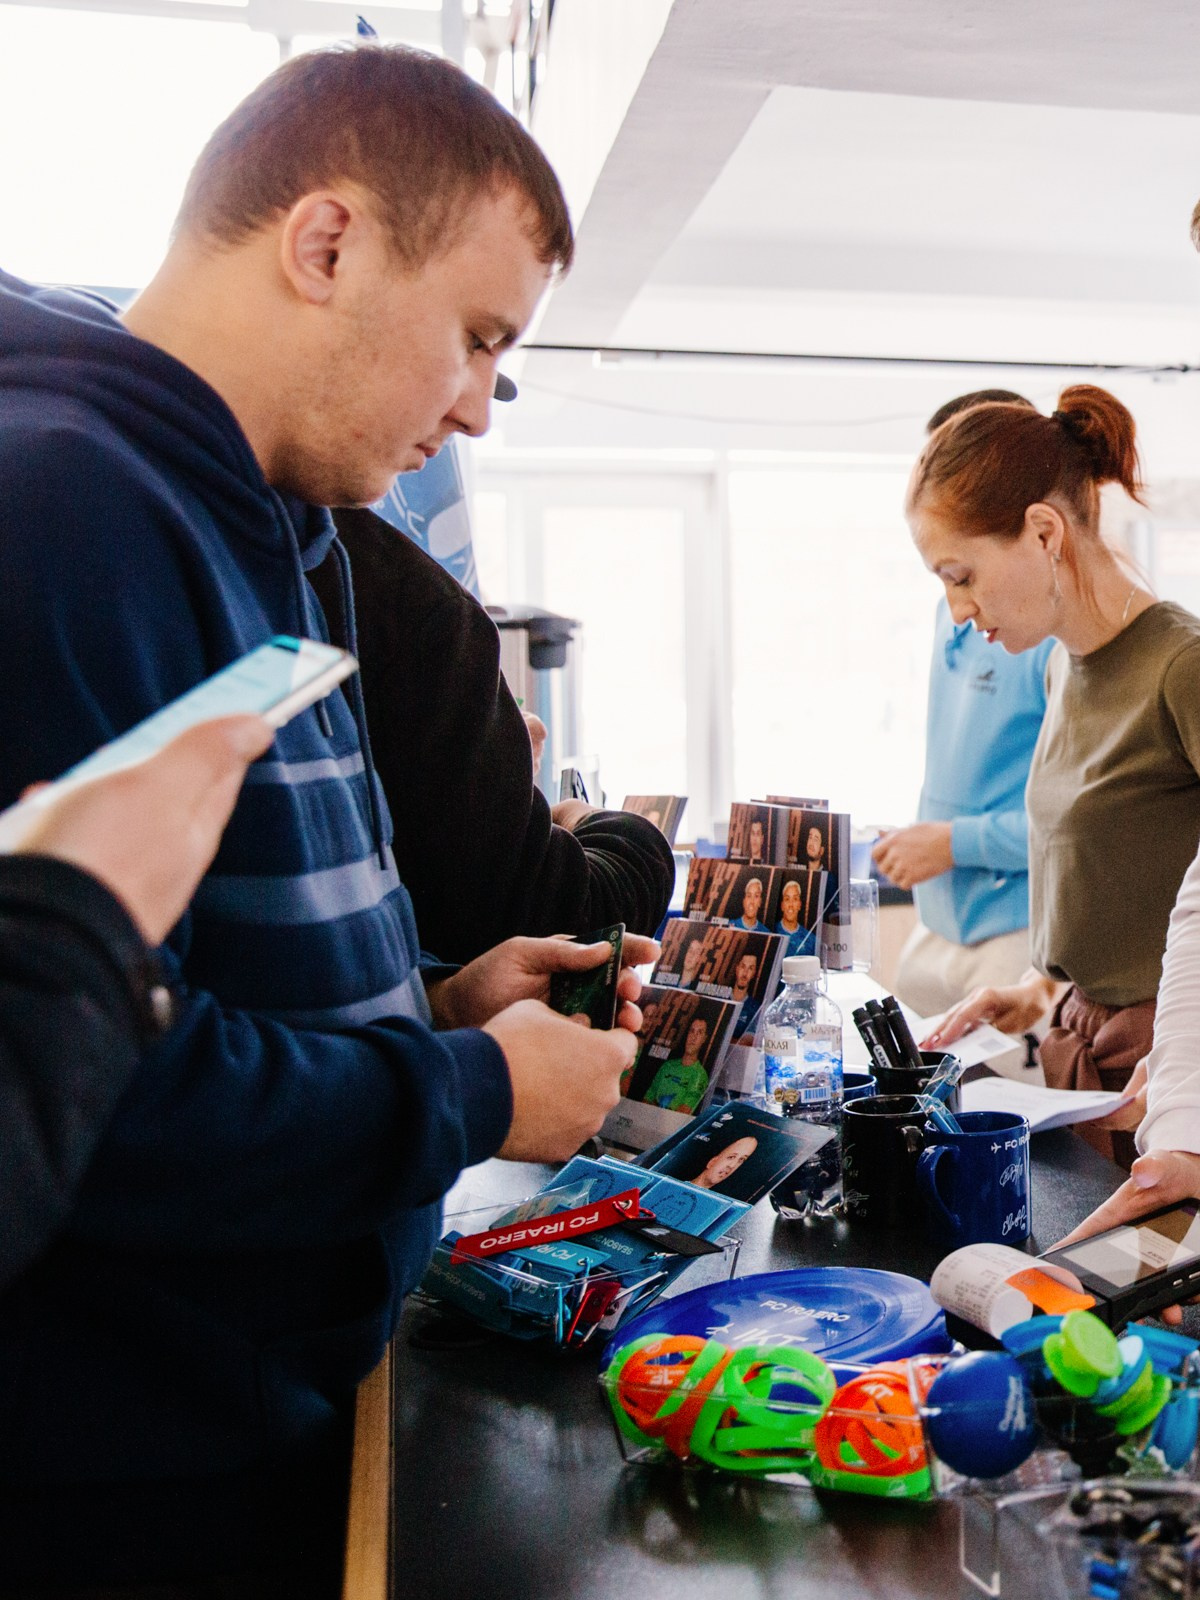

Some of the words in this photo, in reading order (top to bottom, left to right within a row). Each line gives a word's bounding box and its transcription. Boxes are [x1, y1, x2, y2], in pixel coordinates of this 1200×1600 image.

[1004, 1140, 1018, 1151] FC
[569, 1211, 599, 1229] FC
[480, 1221, 565, 1249] IRAERO
[551, 1249, 577, 1261] FC
[601, 1237, 634, 1256] SEASON
[759, 1300, 787, 1311] FC
[785, 1306, 851, 1323] IRAERO
[733, 1327, 809, 1347] IKT
